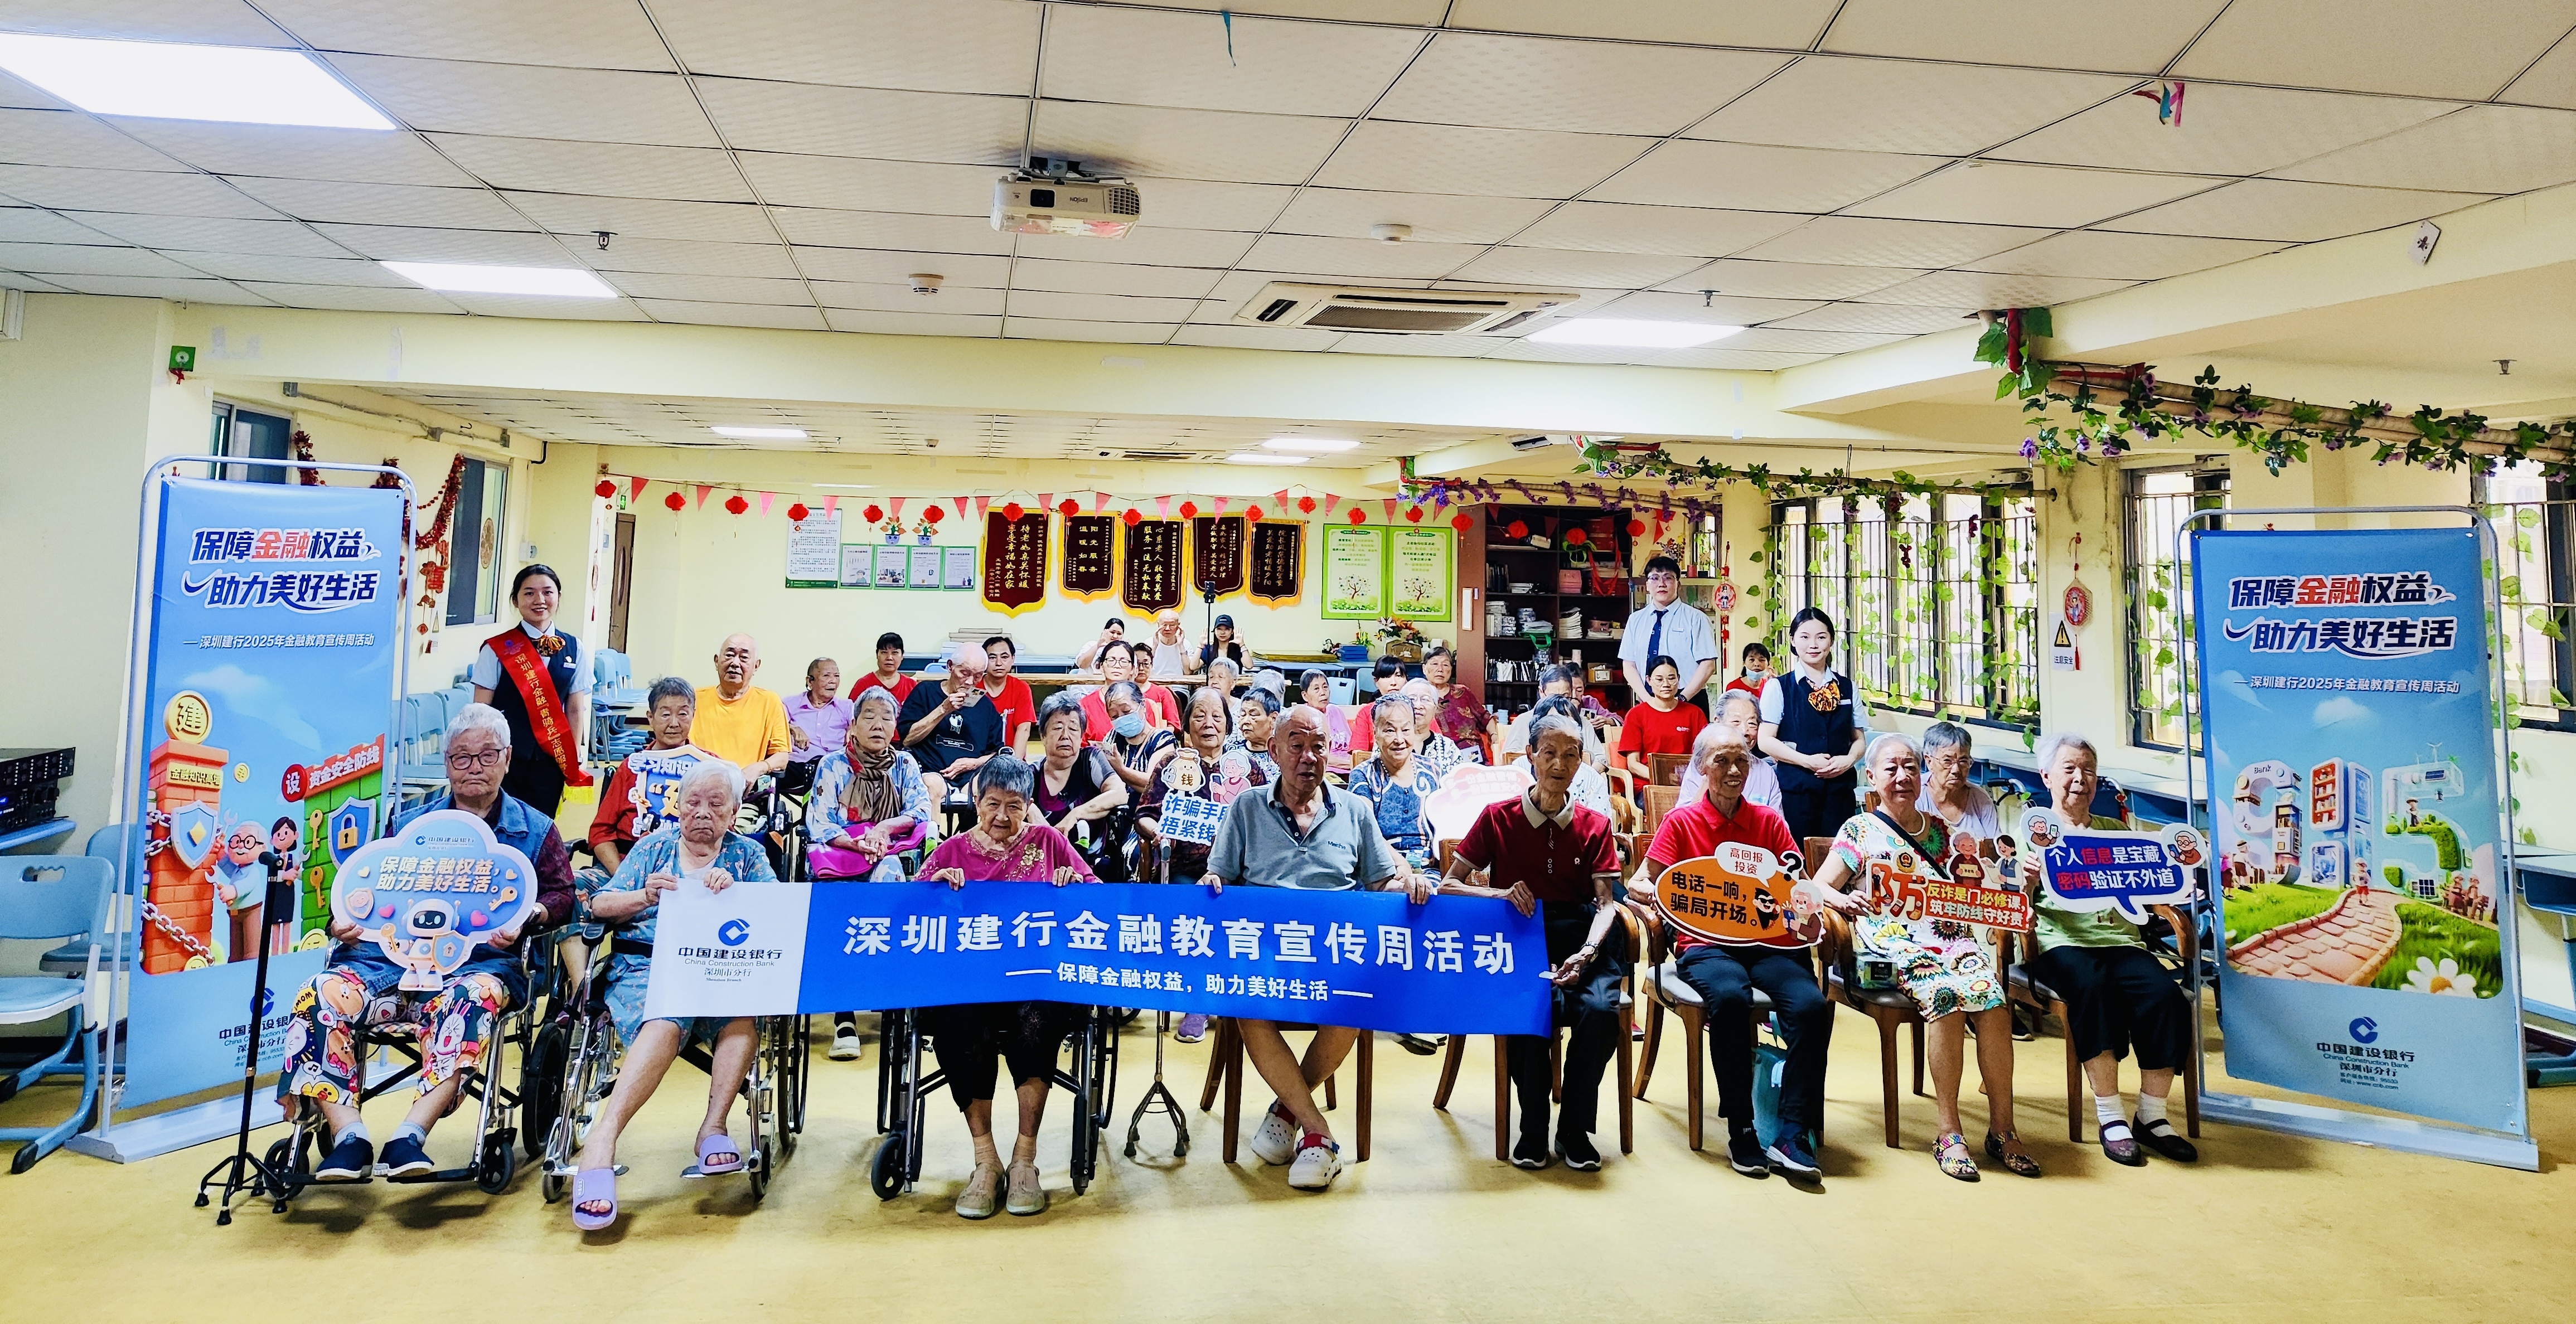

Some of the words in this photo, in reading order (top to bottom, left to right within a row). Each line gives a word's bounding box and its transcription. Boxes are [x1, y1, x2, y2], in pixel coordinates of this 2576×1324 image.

[1078, 526, 1088, 573] 温暖如春
[1088, 526, 1099, 573] 阳光服务
[1141, 526, 1153, 601] 服务一流无私奉献
[207, 572, 379, 609] 助力美好生活
[2253, 619, 2454, 651] 助力美好生活
[2054, 655, 2073, 665] 注意安全
[175, 701, 204, 736] 建
[285, 771, 301, 795] 设
[309, 745, 380, 789] 资金安全防线
[630, 754, 695, 776] 学习知识
[2254, 764, 2272, 774] Bank
[170, 768, 221, 787] 金融知识高墙
[1181, 773, 1194, 786] 钱
[379, 855, 500, 877] 保障金融权益,
[1730, 847, 1764, 864] 高回报
[2049, 845, 2162, 867] 个人信息是宝藏
[1734, 861, 1758, 876] 投资
[2056, 868, 2177, 891] 密码验证不外道
[375, 874, 498, 894] 助力美好生活。
[1671, 871, 1747, 902] 电话一响,
[1871, 863, 1926, 921] 防
[1927, 883, 2026, 913] 反诈是门必修课,
[1670, 892, 1758, 927] 骗局开场。
[842, 909, 1515, 975] 深圳建行金融教育宣传周活动
[678, 947, 783, 960] 中国建设银行
[704, 967, 752, 977] 深圳市分行
[219, 1016, 289, 1040] 中国设银
[224, 1037, 243, 1047] China
[237, 1035, 287, 1054] 深市分行
[2316, 1041, 2416, 1063] 中国建设银行
[2323, 1053, 2344, 1061] China
[2345, 1055, 2390, 1067] Construction
[2390, 1061, 2410, 1069] Bank
[2339, 1061, 2398, 1078] 深圳市分行
